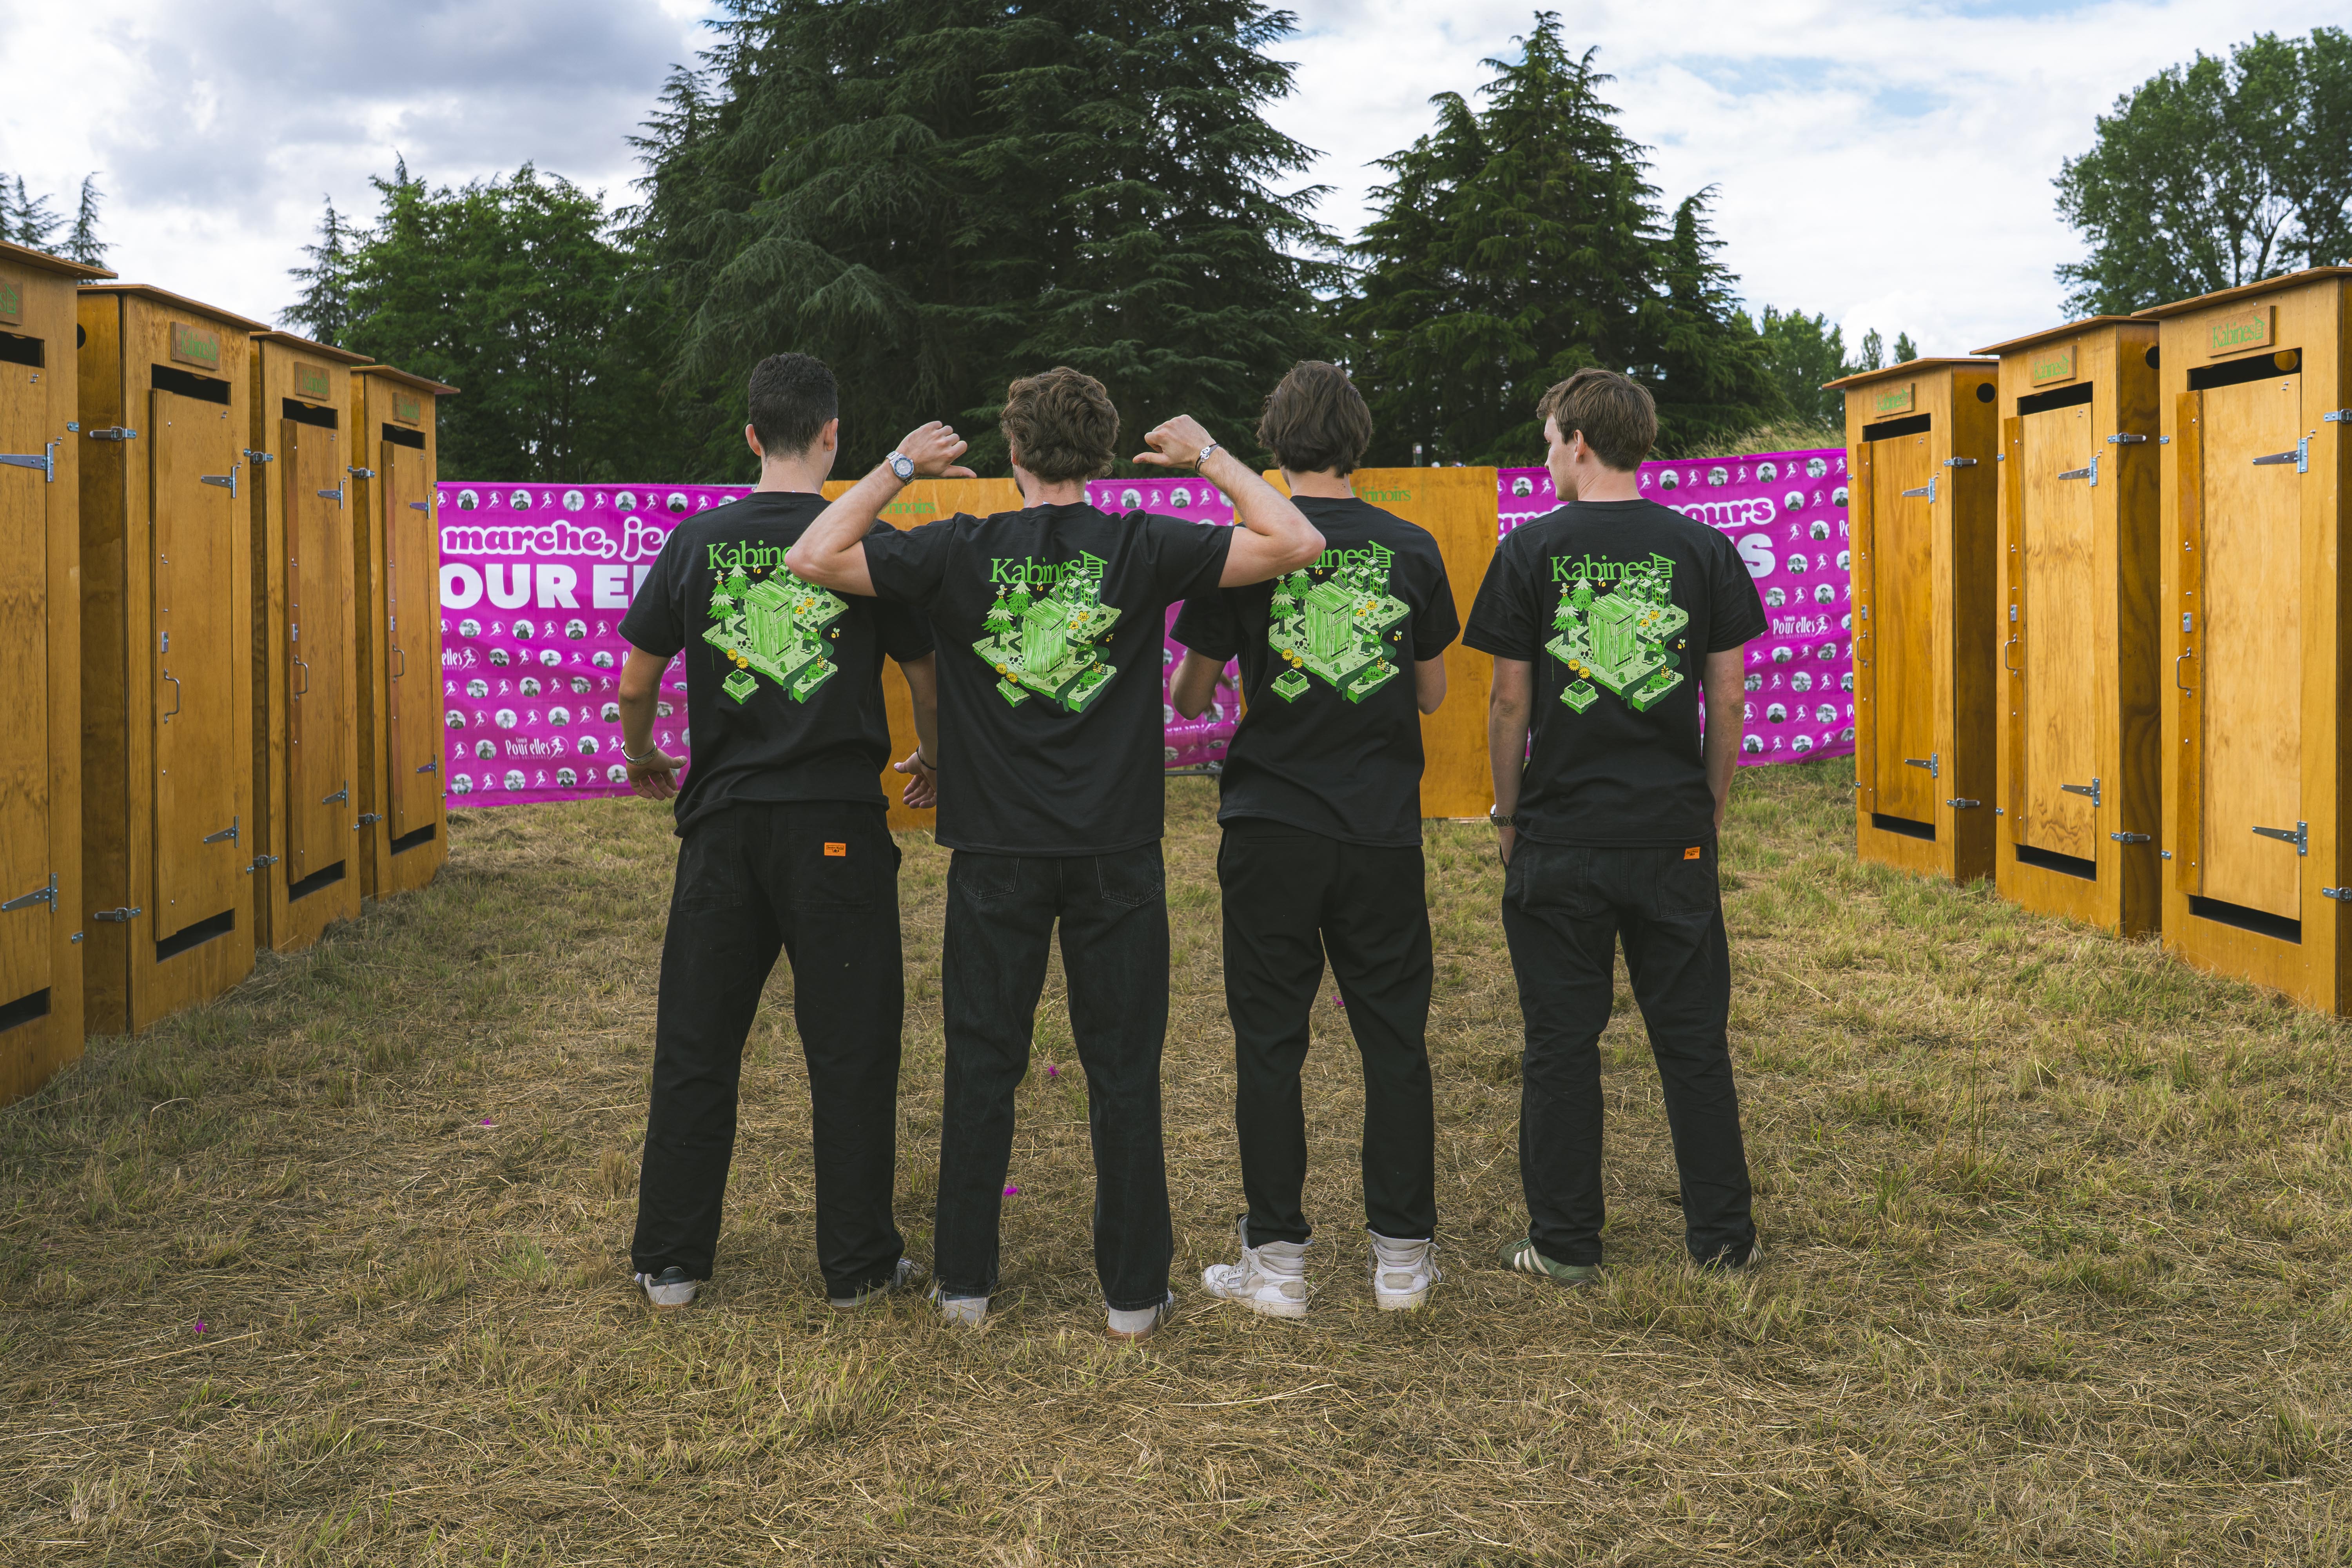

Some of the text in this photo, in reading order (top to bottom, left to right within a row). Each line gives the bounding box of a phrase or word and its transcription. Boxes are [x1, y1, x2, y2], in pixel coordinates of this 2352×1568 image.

[180, 330, 210, 359] Kabines
[2212, 321, 2254, 348] Kabines
[2034, 358, 2062, 381] Kabines
[1667, 497, 1776, 529] ours
[441, 520, 617, 559] marche,
[989, 556, 1081, 584] Kabines
[1550, 554, 1651, 582] Kabines
[1773, 616, 1815, 635] Pour elles
[505, 738, 550, 755] Pour elles
